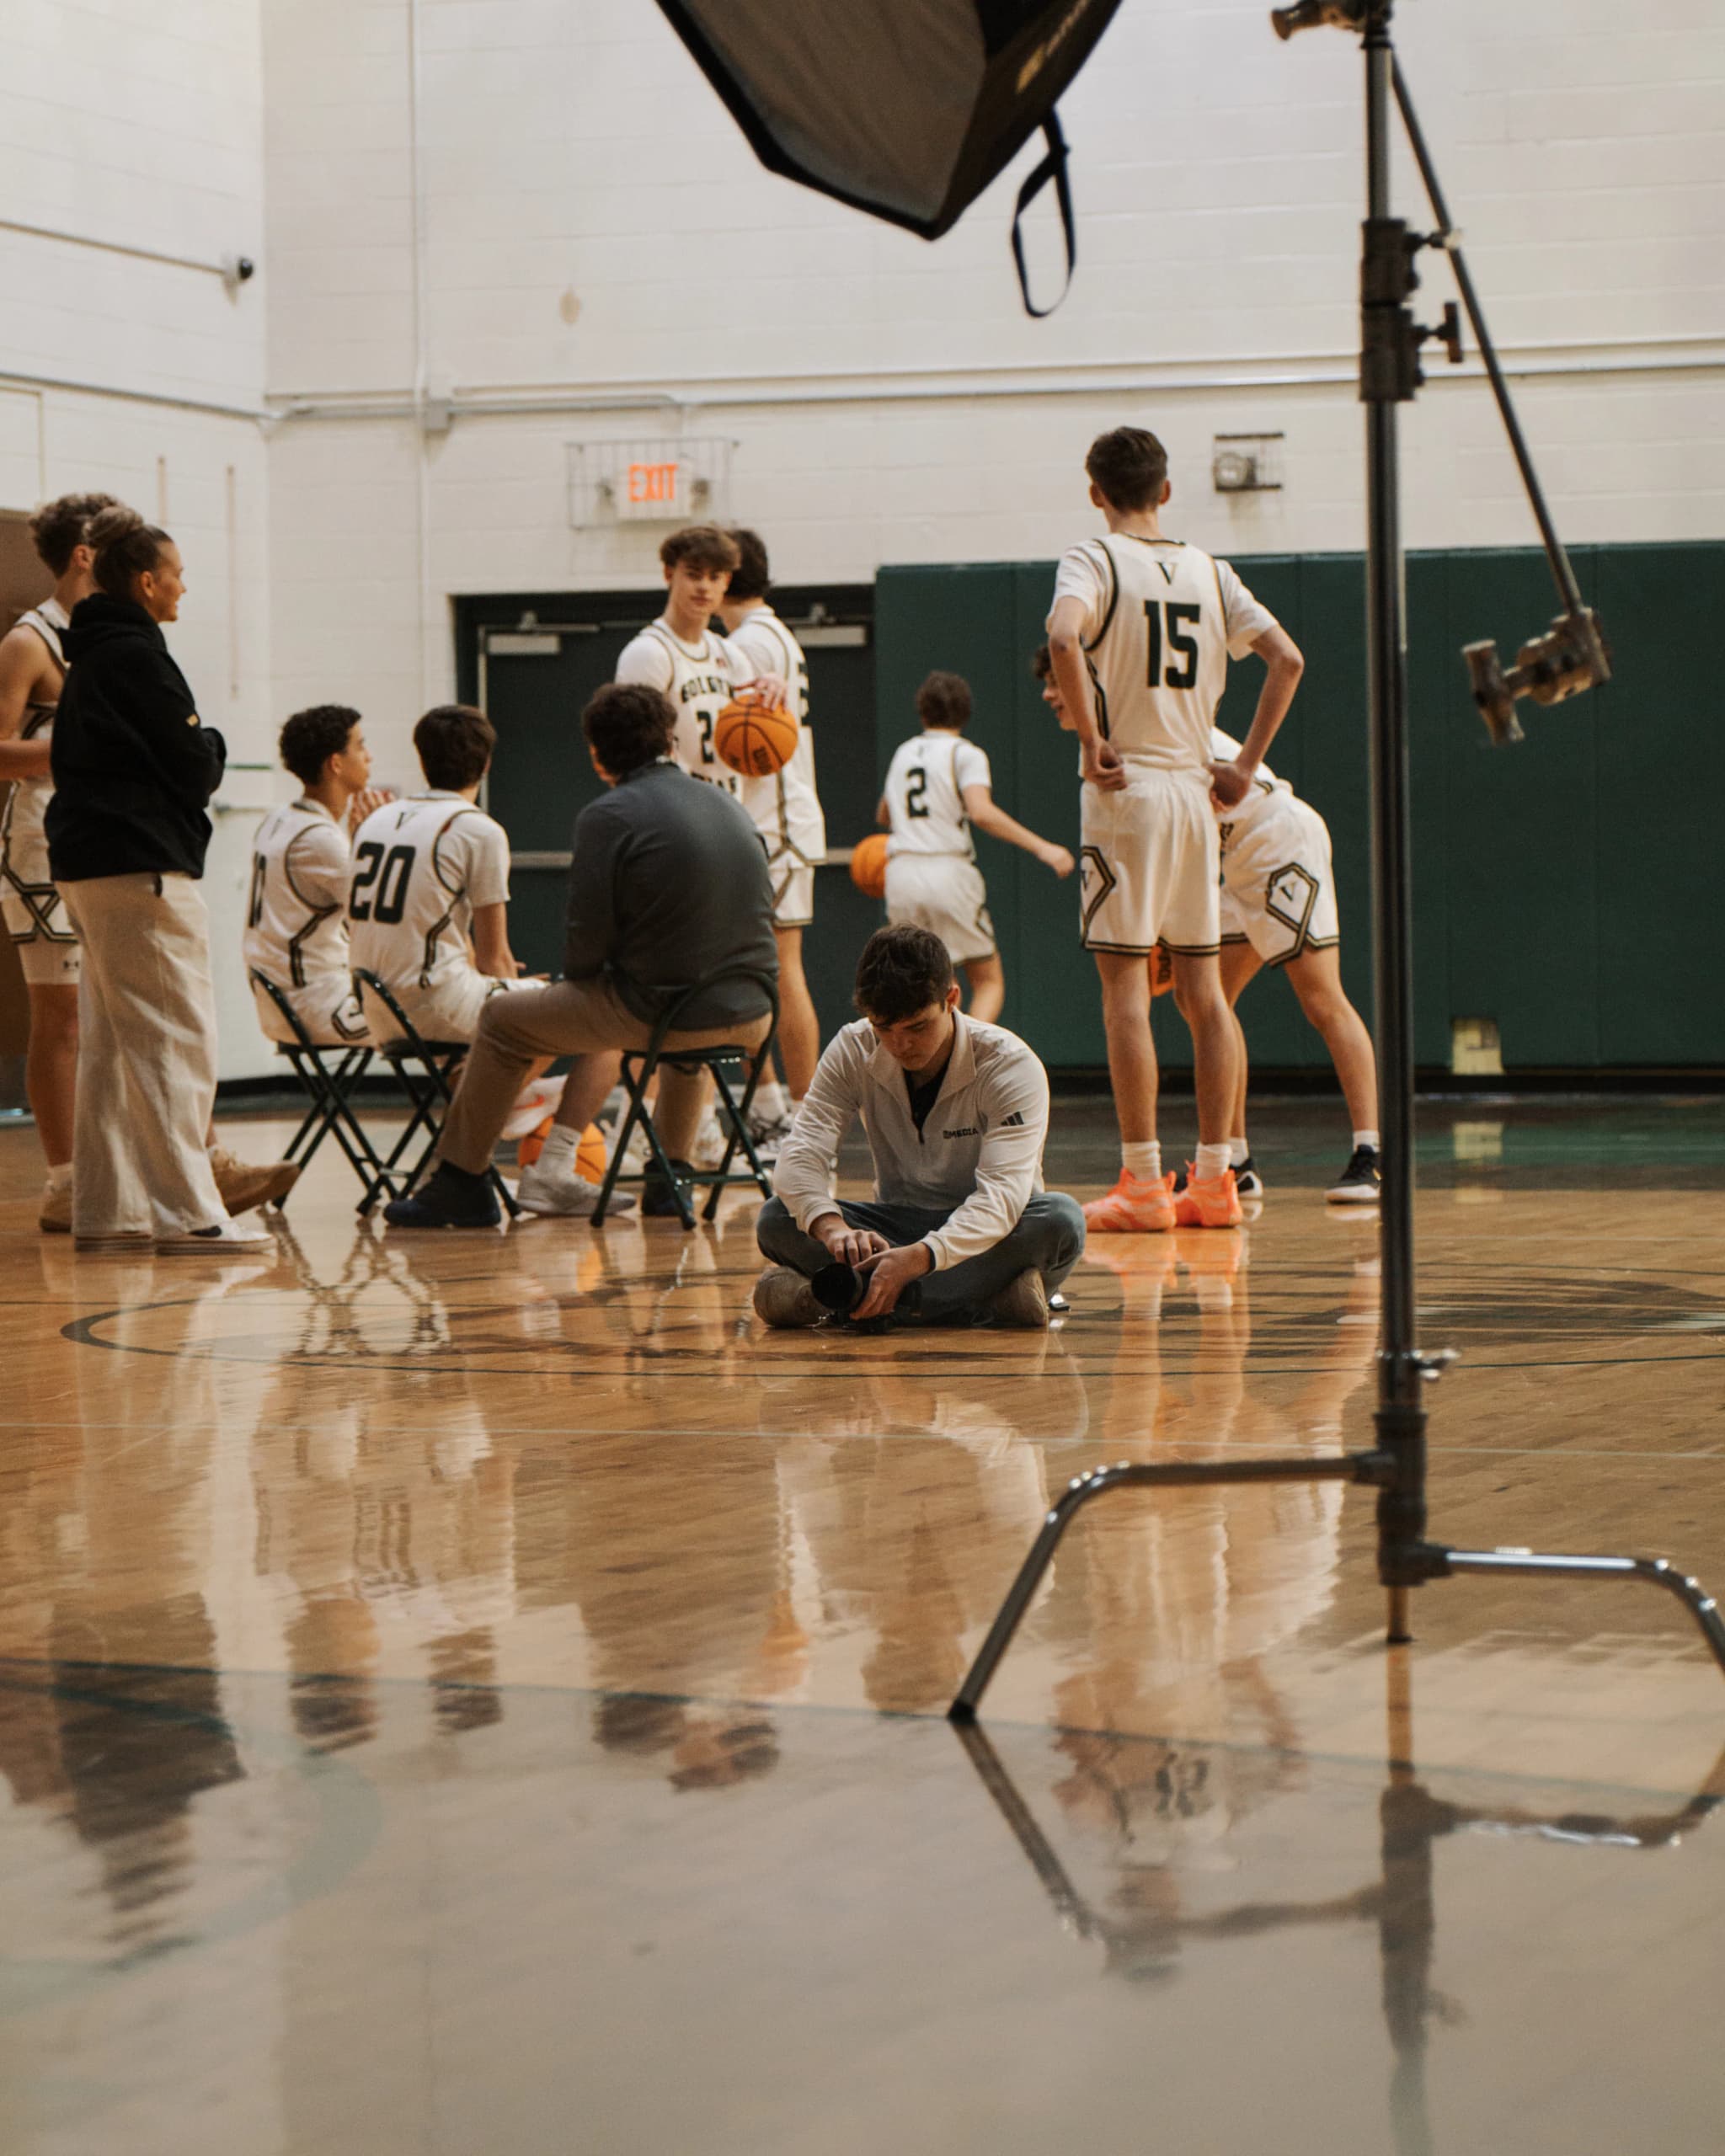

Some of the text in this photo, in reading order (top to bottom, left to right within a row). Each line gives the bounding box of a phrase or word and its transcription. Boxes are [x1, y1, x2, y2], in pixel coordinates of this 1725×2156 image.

[628, 463, 679, 502] EXIT
[1156, 561, 1178, 584] V
[1144, 600, 1201, 690] 15
[906, 767, 929, 819] 2
[349, 841, 416, 925] 20
